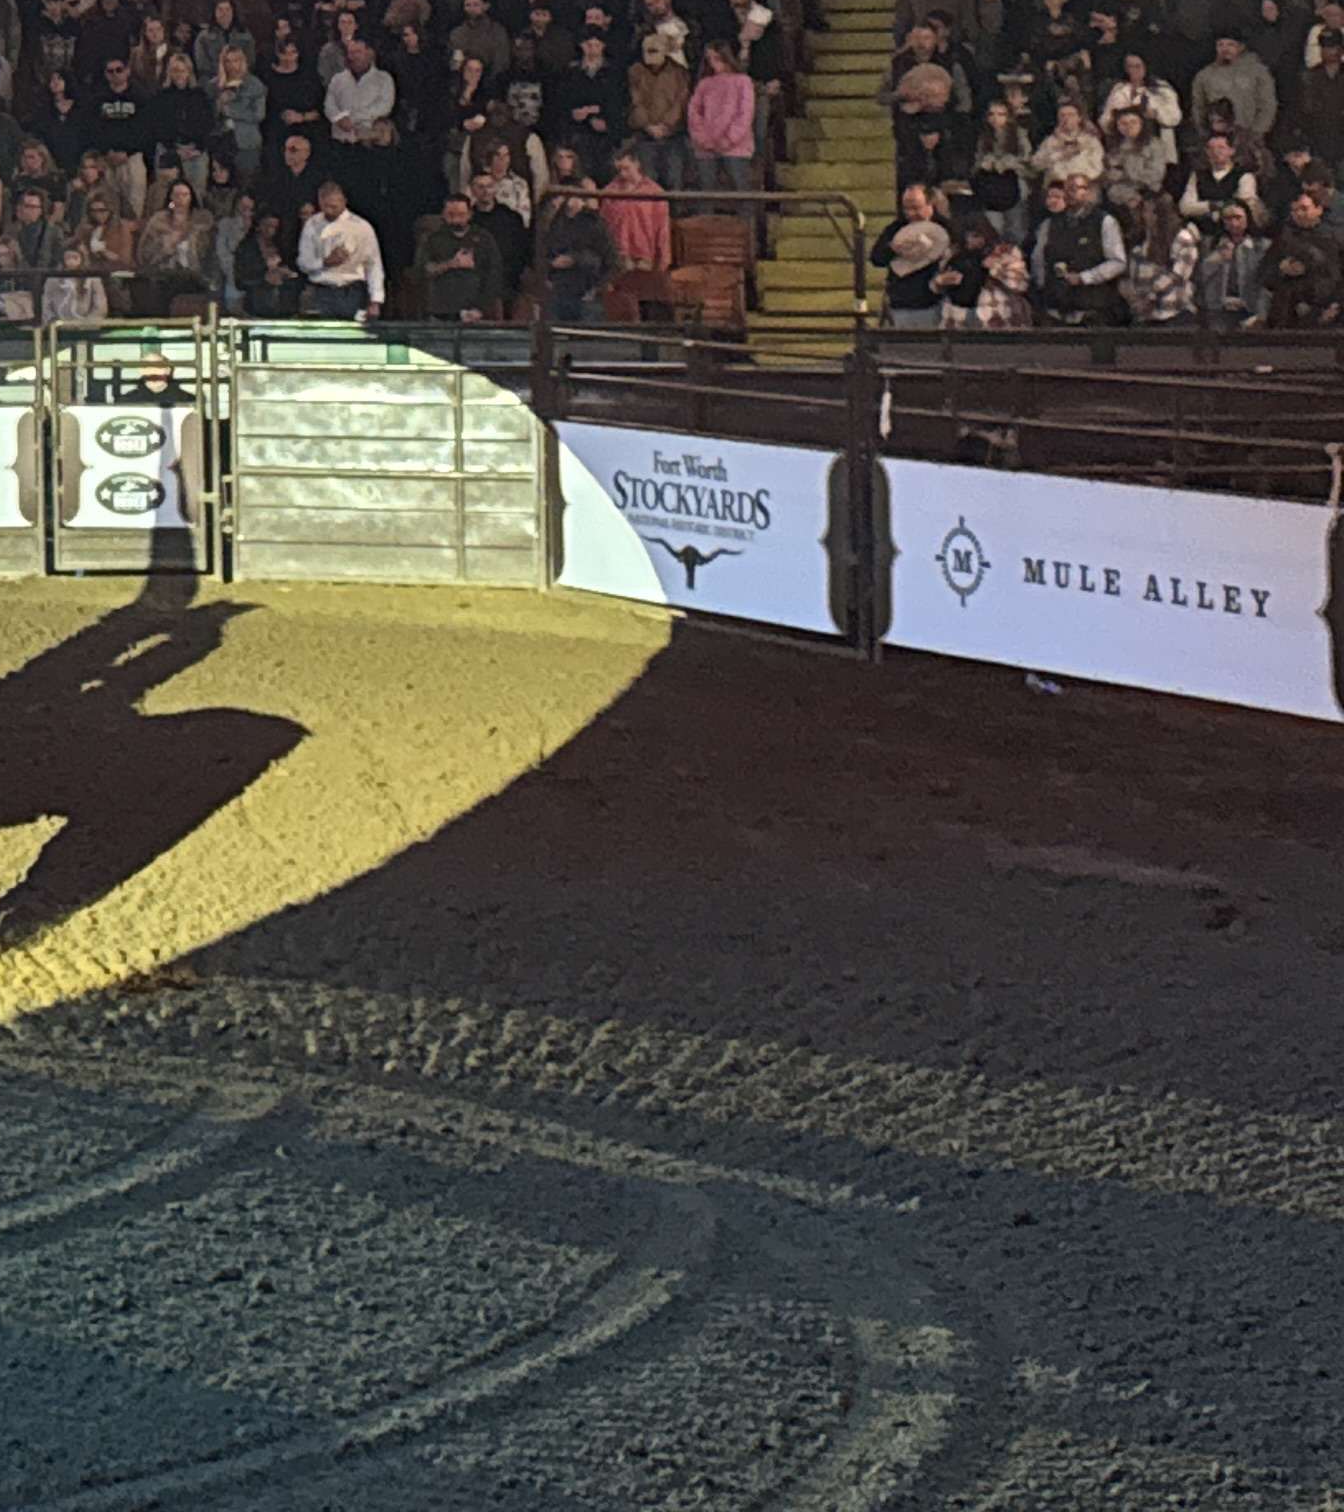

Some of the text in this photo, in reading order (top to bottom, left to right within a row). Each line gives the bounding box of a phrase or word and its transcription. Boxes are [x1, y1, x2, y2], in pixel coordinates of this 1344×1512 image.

[653, 450, 728, 483] Fort Worth
[613, 469, 771, 530] STOCKYARDS
[1022, 557, 1273, 619] MULE ALLEY
